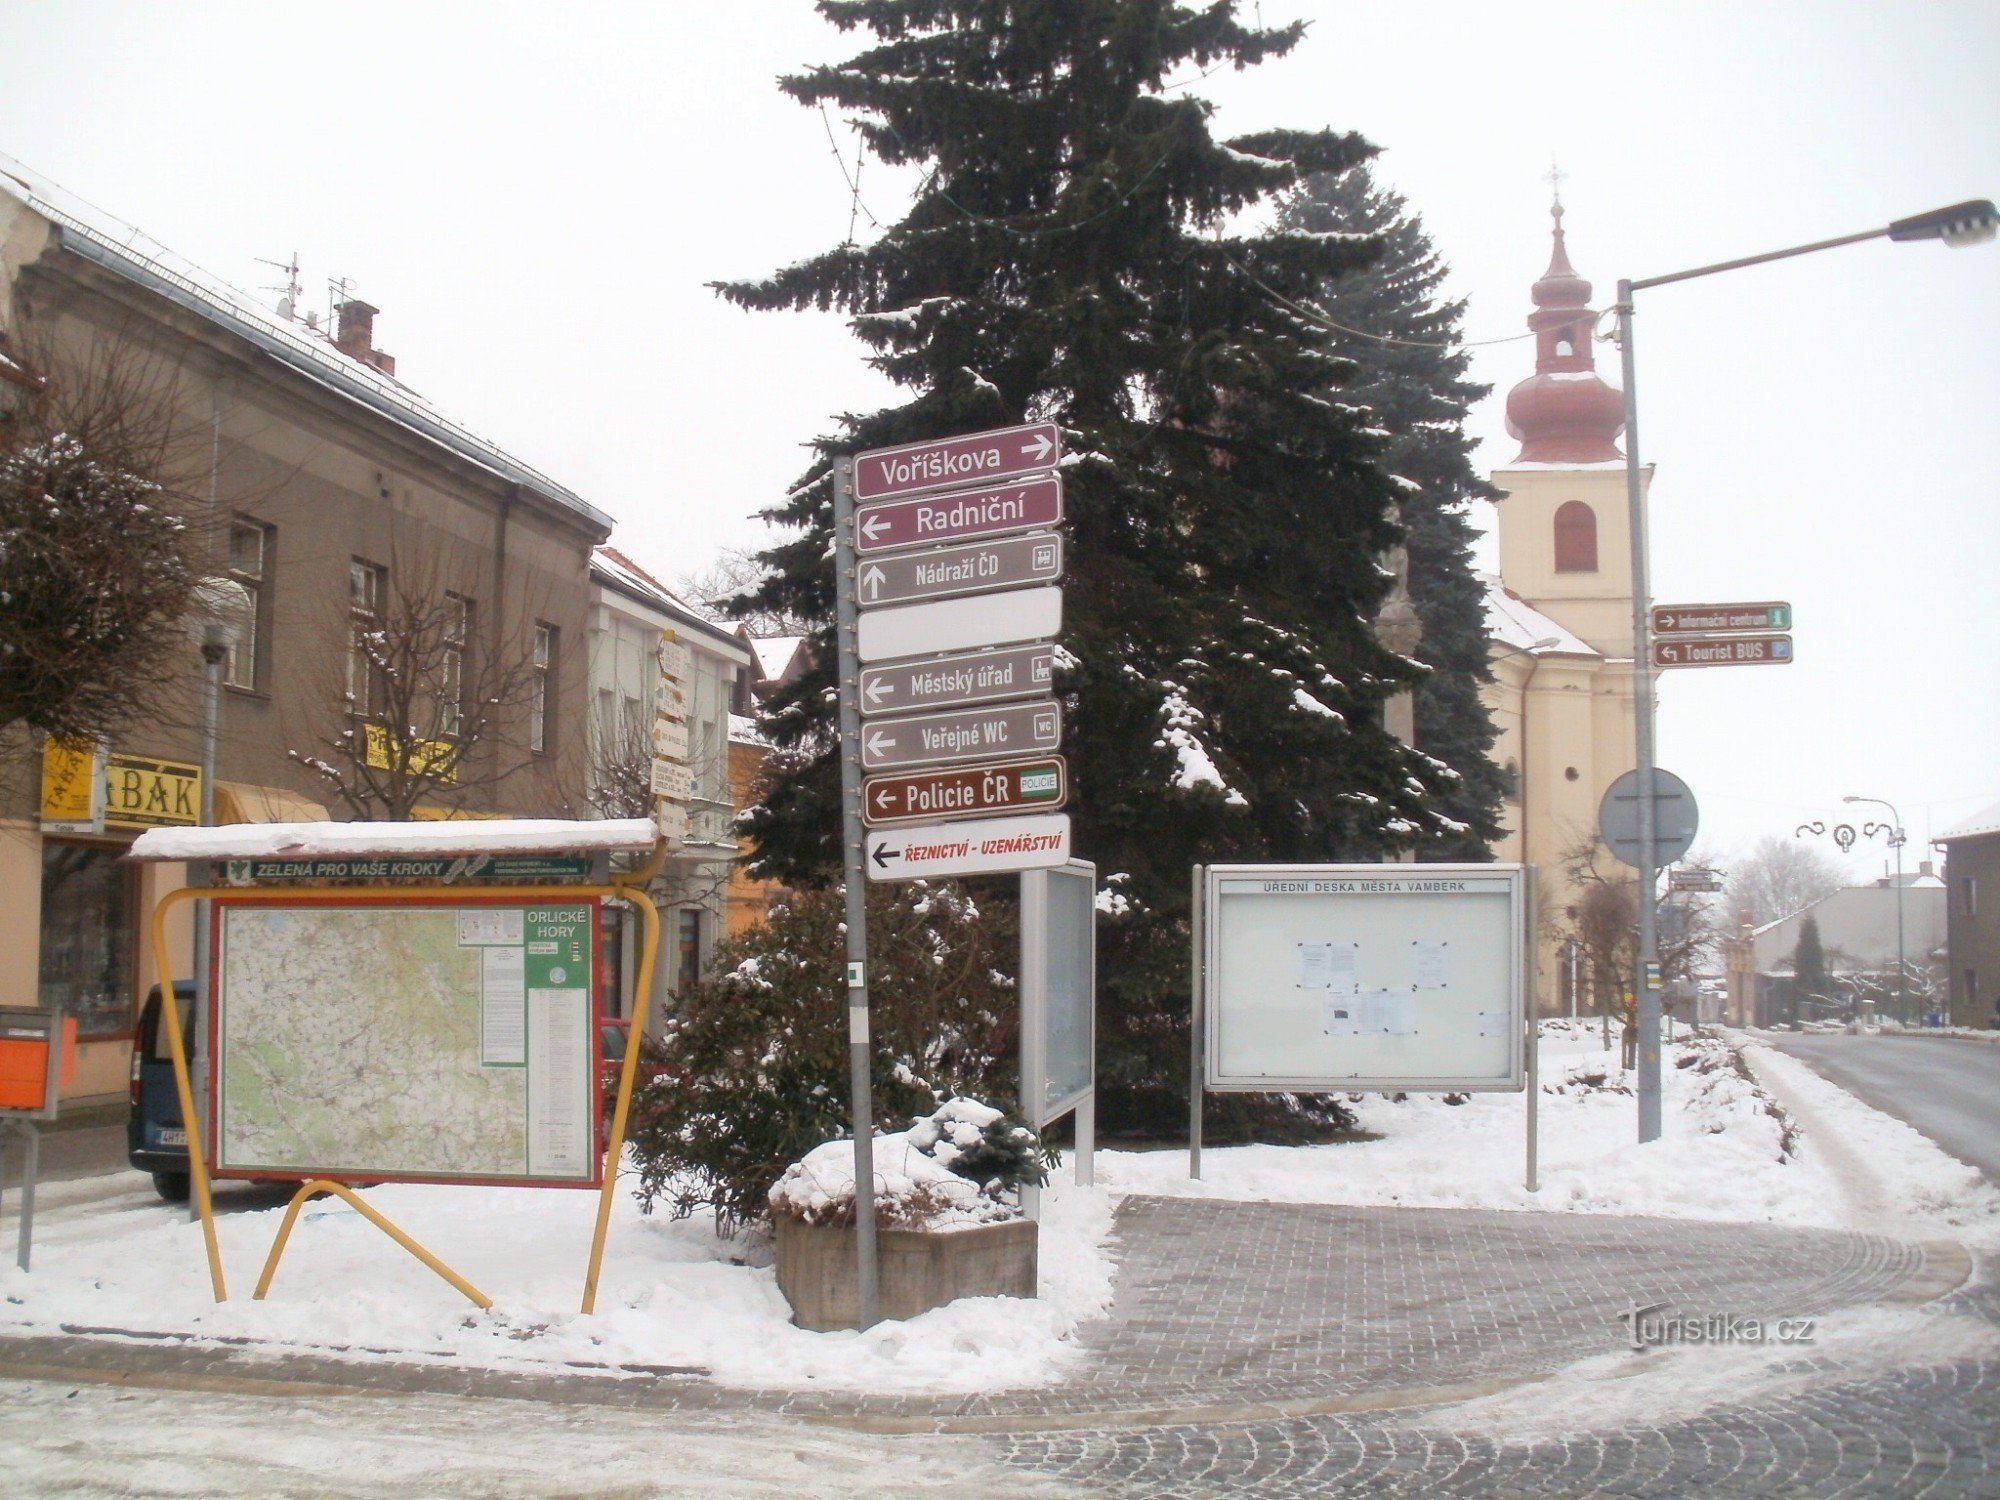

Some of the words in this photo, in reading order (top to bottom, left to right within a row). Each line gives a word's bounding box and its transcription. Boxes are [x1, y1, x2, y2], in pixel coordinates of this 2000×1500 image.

[881, 449, 1001, 485] Voříškova
[917, 492, 1026, 532] Radniční
[916, 558, 975, 586] Nádraží
[978, 553, 999, 577] ČD
[1684, 644, 1732, 660] Tourist
[1736, 642, 1764, 658] BUS
[911, 668, 973, 696] Městský
[978, 663, 1013, 688] úřad
[922, 725, 979, 751] Veřejné
[983, 721, 1008, 743] WC
[1038, 721, 1051, 732] WC
[907, 780, 974, 811] Policie
[983, 770, 1009, 803] ČR
[1021, 776, 1055, 789] POLICIE
[904, 838, 970, 862] ŘEZNICTVÍ
[980, 830, 1063, 855] UZENÁŘSTVÍ
[257, 861, 313, 876] ZELENÁ
[316, 864, 347, 876] PRO
[352, 859, 388, 875] VAŠE
[391, 863, 442, 875] KROKY
[1264, 880, 1308, 892] ÚŘEDNÍ
[1315, 883, 1355, 892] DESKA
[1361, 881, 1401, 892] MĚSTA
[1408, 882, 1465, 892] VAMBERK
[527, 909, 586, 923] ORLICKÉ
[537, 926, 576, 937] HORY
